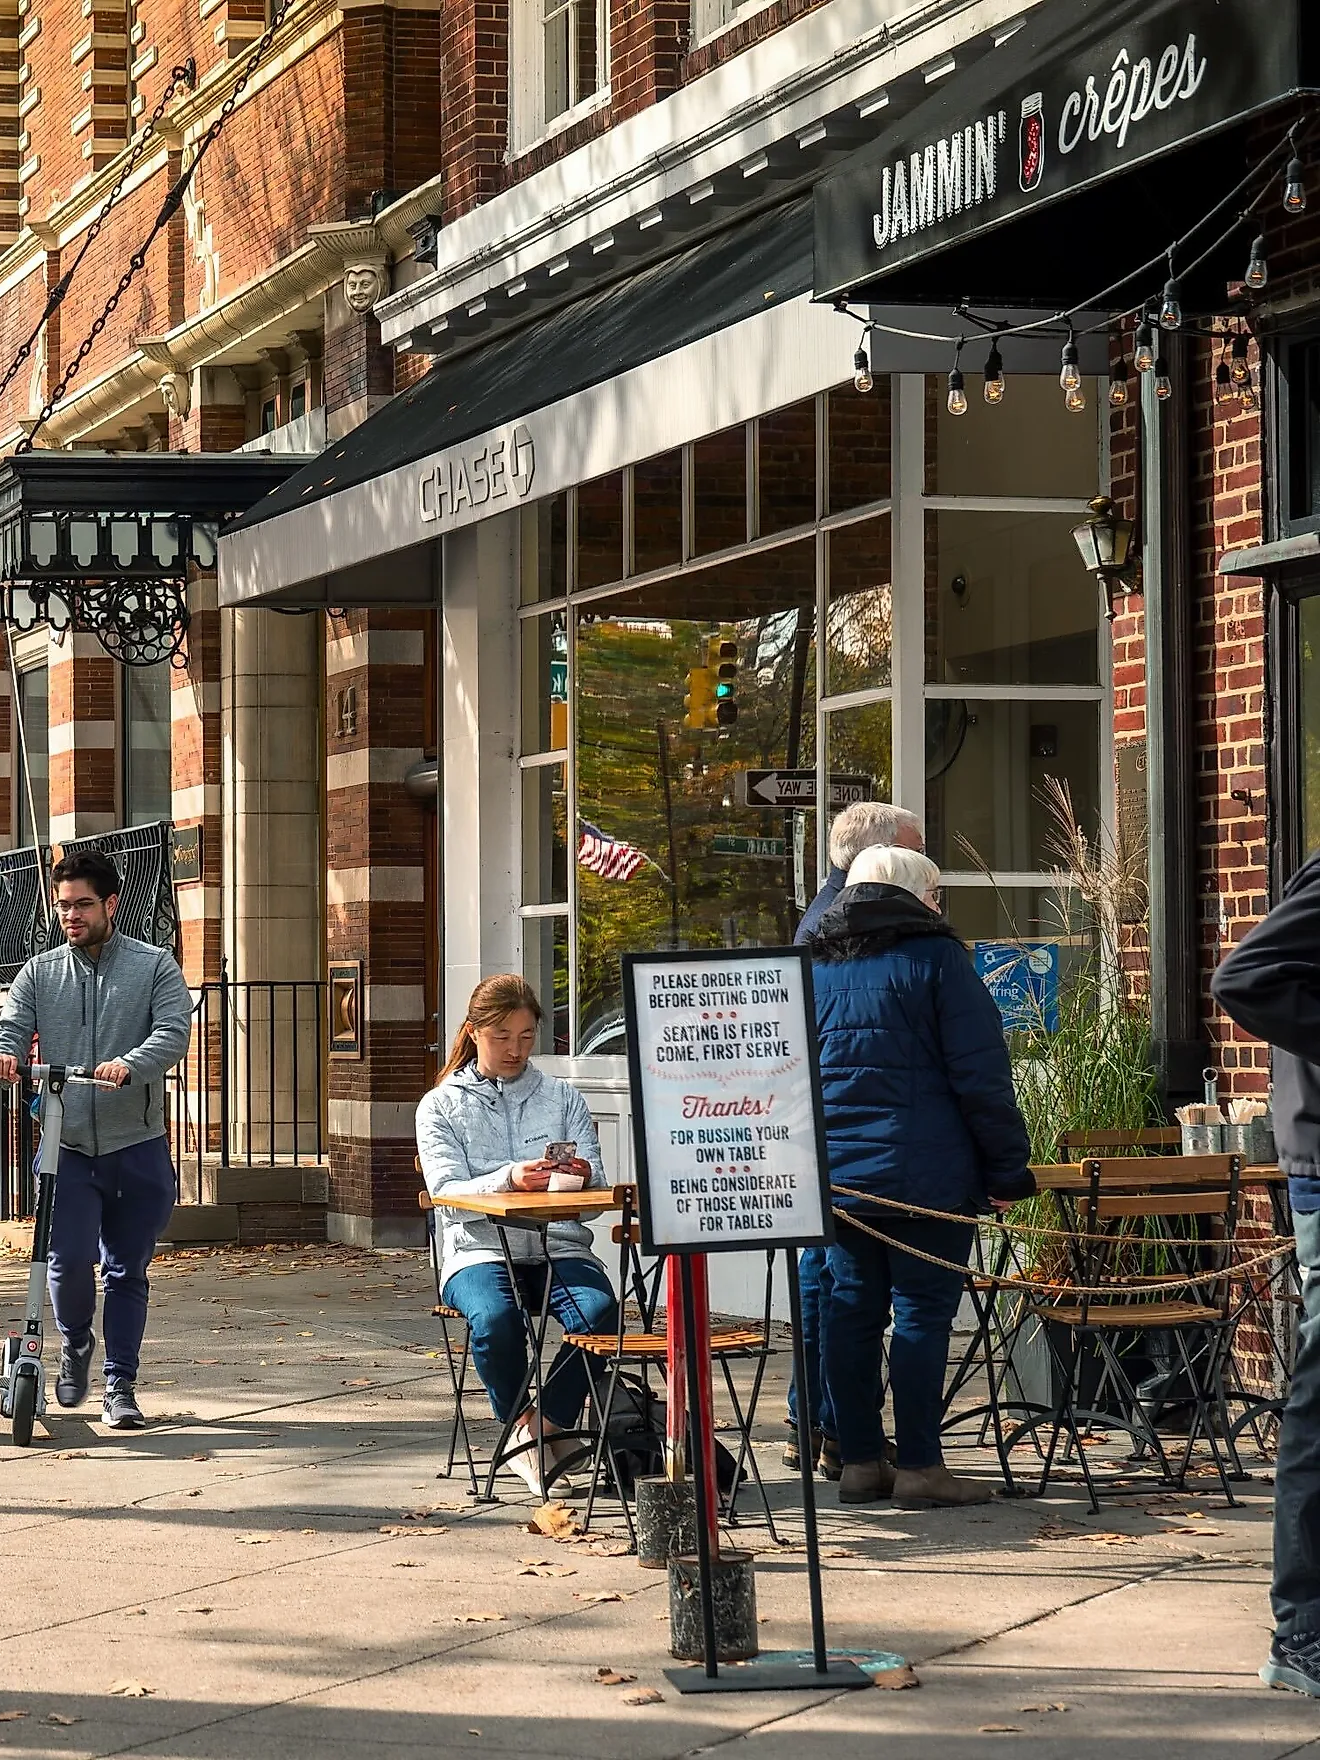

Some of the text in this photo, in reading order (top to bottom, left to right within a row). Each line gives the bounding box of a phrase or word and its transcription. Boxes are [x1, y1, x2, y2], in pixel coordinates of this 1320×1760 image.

[873, 33, 1207, 250] JAMMIN' crêpes
[420, 440, 508, 522] CHASE
[333, 685, 357, 738] 14
[652, 969, 782, 990] PLEASE ORDER FIRST
[649, 988, 789, 1009] BEFORE SITTING DOWN
[989, 985, 1019, 1001] iring
[663, 1021, 780, 1043] SEATING IS FIRST
[656, 1040, 790, 1063] COME, FIRST SERVE
[682, 1094, 774, 1119] Thanks!
[670, 1125, 789, 1145] FOR BUSSING YOUR
[696, 1145, 766, 1163] OWN TABLE
[670, 1174, 797, 1194] BEING CONSIDERATE
[676, 1193, 793, 1214] OF THOSE WAITING
[699, 1213, 773, 1232] FOR TABLES
